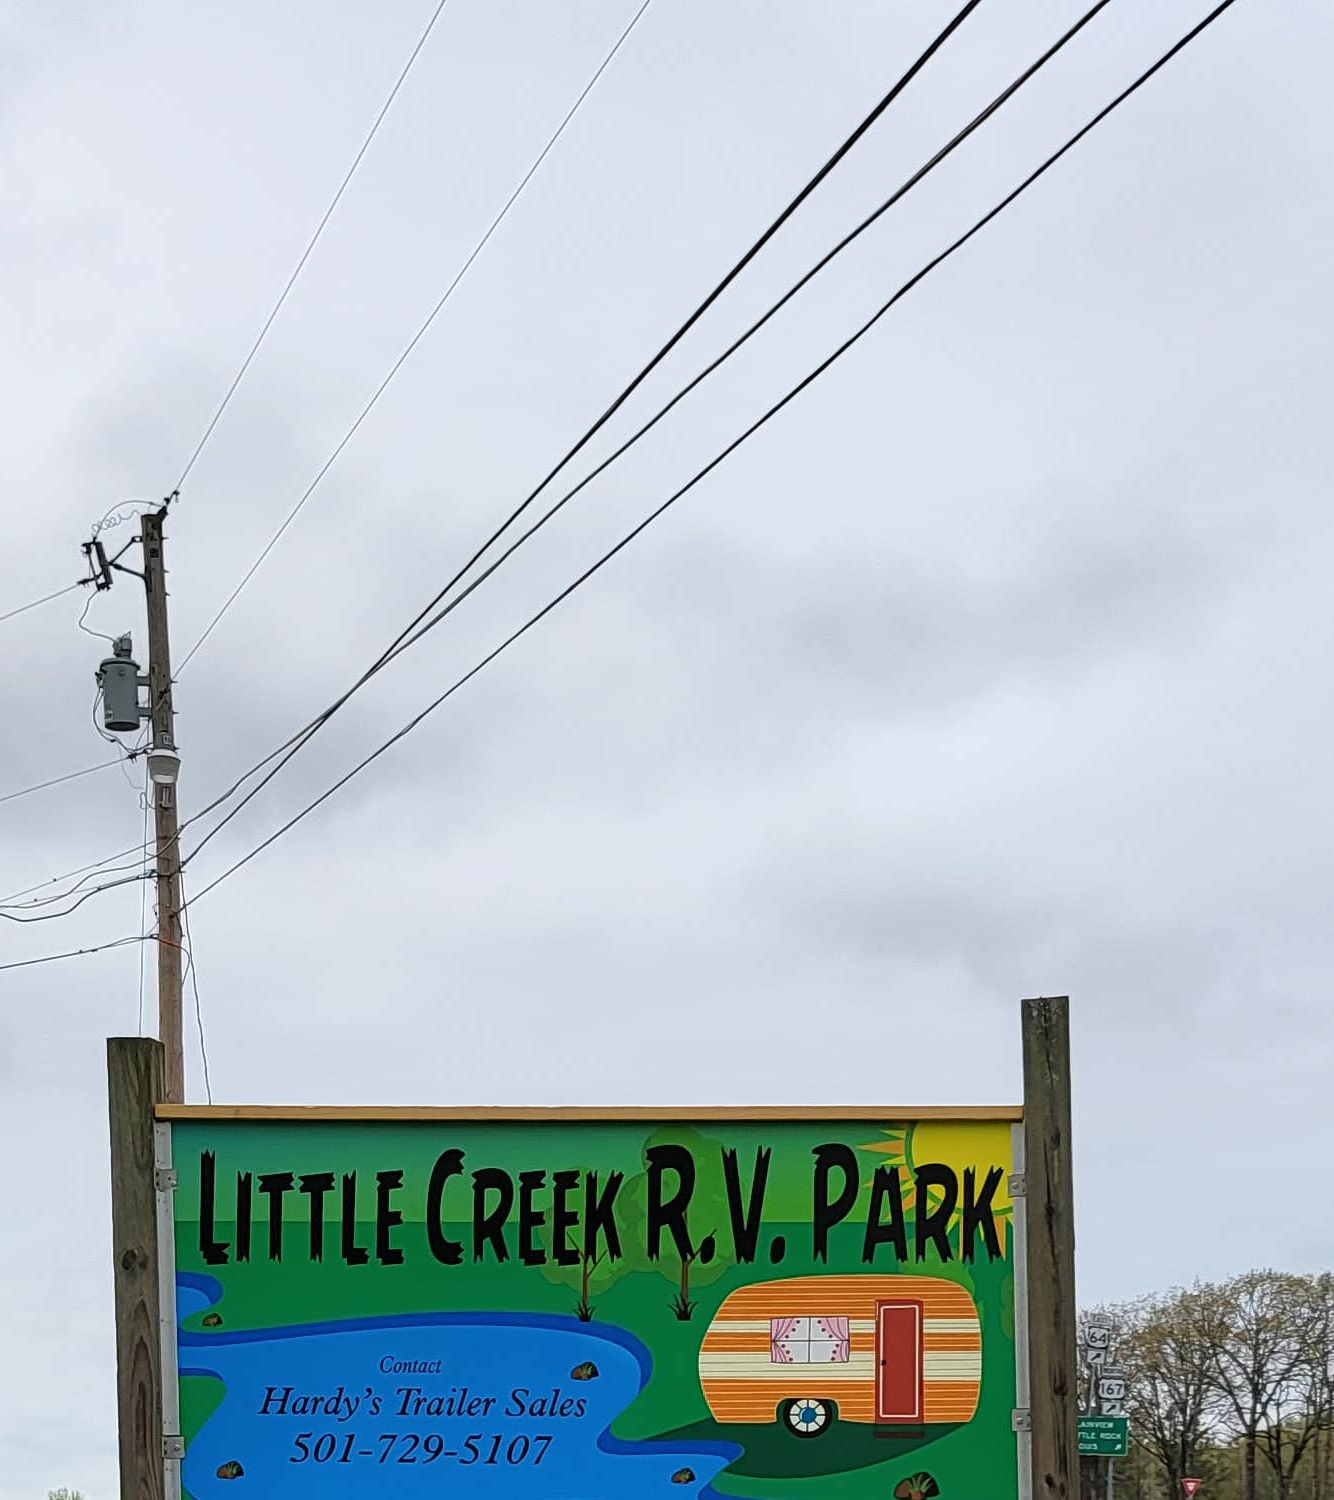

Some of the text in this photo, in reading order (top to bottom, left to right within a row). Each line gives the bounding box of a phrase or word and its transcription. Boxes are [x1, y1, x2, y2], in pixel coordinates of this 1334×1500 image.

[198, 1143, 1005, 1267] LITTLE CREEK R.V. PARK
[1090, 1332, 1107, 1344] 64
[379, 1356, 442, 1374] Contact
[1100, 1383, 1123, 1395] 167
[258, 1386, 588, 1422] Hardy's Trailer Sales
[289, 1432, 554, 1466] 501-729-5107
